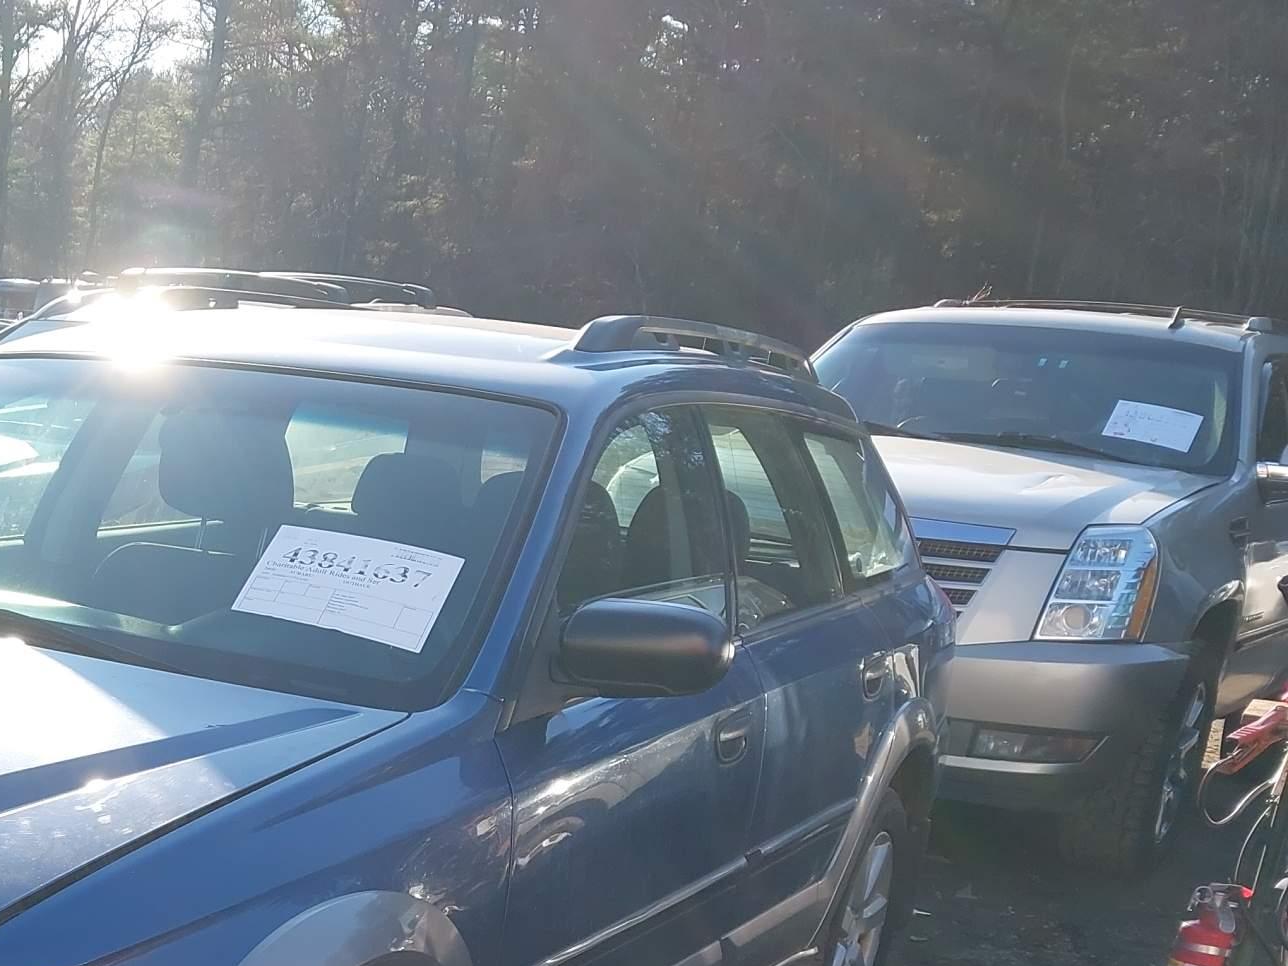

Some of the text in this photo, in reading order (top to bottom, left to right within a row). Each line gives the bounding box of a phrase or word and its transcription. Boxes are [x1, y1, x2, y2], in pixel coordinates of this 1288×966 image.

[266, 560, 305, 570] Charitable
[329, 569, 350, 580] Rides
[351, 575, 366, 583] and
[282, 547, 433, 588] 43841637
